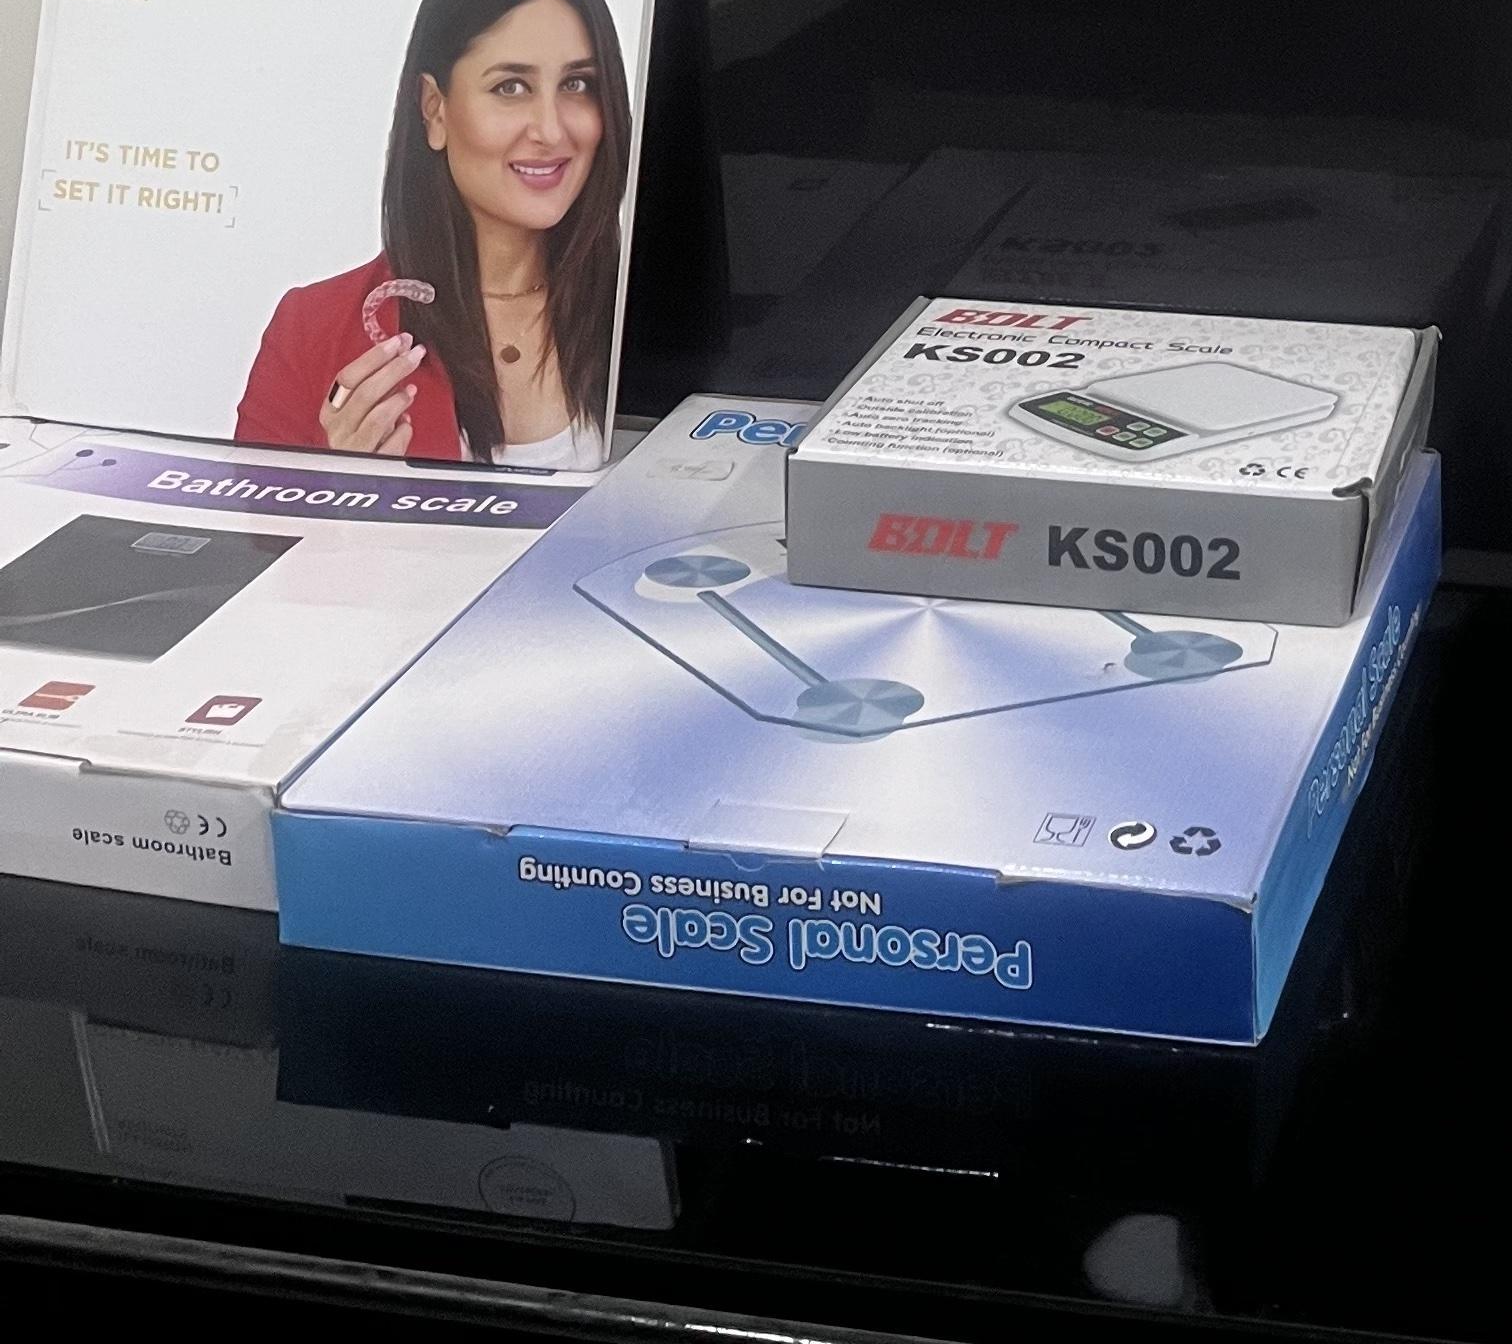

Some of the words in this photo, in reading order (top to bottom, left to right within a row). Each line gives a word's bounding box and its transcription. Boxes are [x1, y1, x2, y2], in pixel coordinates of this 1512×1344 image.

[65, 140, 110, 163] IT'S
[119, 145, 178, 169] TIME
[186, 150, 220, 173] TO
[53, 179, 100, 202] SET
[107, 183, 131, 205] IT
[138, 186, 224, 214] RIGHT!
[933, 308, 1093, 331] BOLT
[916, 326, 1037, 343] Electronic
[1048, 335, 1154, 351] Compact
[1167, 342, 1234, 355] Scale
[903, 342, 1087, 369] KS002
[848, 412, 879, 420] Auto
[912, 417, 963, 426] tracking
[875, 423, 933, 433] backlight
[827, 437, 884, 448] Counting
[887, 443, 940, 452] function
[147, 469, 380, 509] Bathroom
[392, 492, 520, 516] scale
[866, 512, 1019, 560] BOLT
[1047, 525, 1241, 581] KS002
[72, 828, 125, 846] scale
[132, 836, 232, 866] Bathroom
[519, 857, 642, 895] Counting
[650, 872, 769, 907] Business
[778, 889, 822, 909] For
[831, 892, 881, 915] Not
[622, 904, 774, 965] Scale
[788, 918, 1034, 990] Personal
